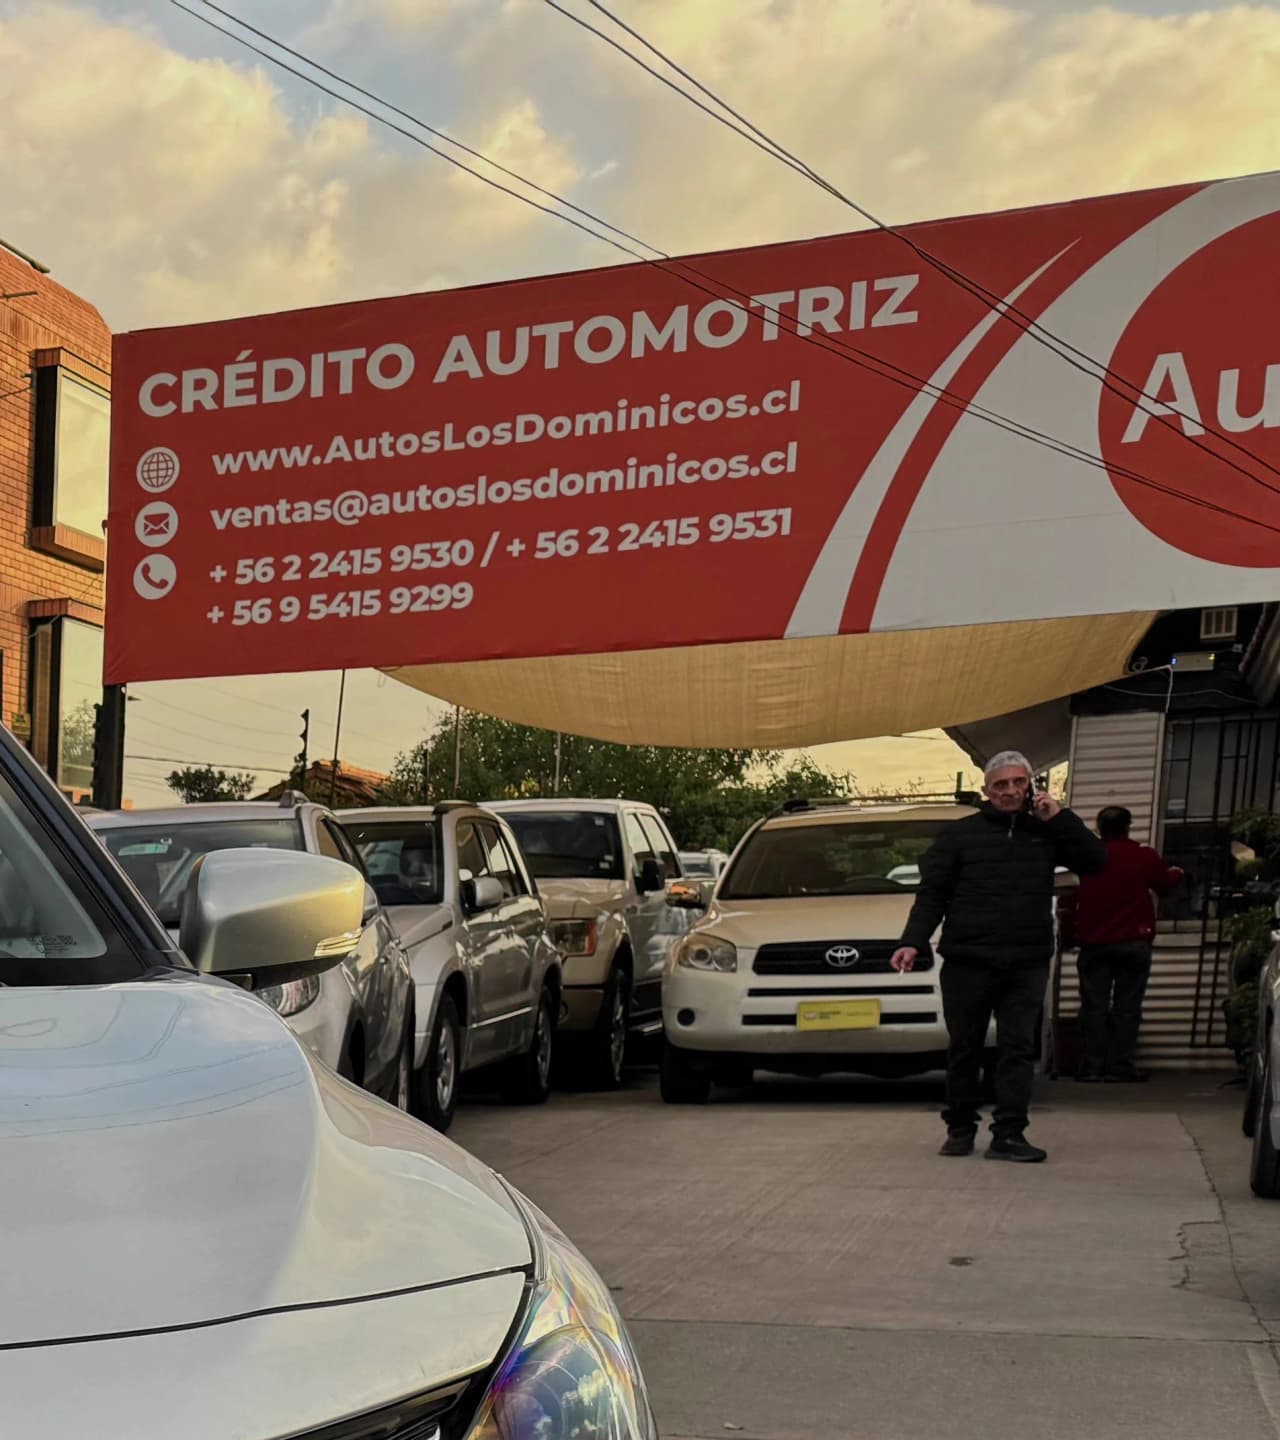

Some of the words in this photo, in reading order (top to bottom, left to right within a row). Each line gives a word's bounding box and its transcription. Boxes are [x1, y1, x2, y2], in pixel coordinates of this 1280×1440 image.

[138, 342, 416, 418] CRÉDITO
[432, 273, 920, 384] AUTOMOTRIZ
[211, 380, 801, 475] www.AutosLosDominicos.cl
[210, 442, 798, 530] ventas@autoslosdominicos.cl
[209, 564, 227, 583] +
[234, 556, 276, 585] 56
[281, 554, 302, 581] 2
[308, 547, 383, 579] 2415
[389, 539, 475, 572] 9530
[479, 530, 501, 568] /
[506, 538, 526, 558] +
[533, 528, 580, 560] 56
[586, 526, 610, 555] 2
[617, 516, 700, 552] 2415
[708, 507, 793, 543] 9531
[206, 605, 225, 624] +
[231, 597, 273, 626] 56
[279, 595, 301, 623] 9
[307, 588, 382, 621] 5415
[389, 581, 474, 614] 9299
